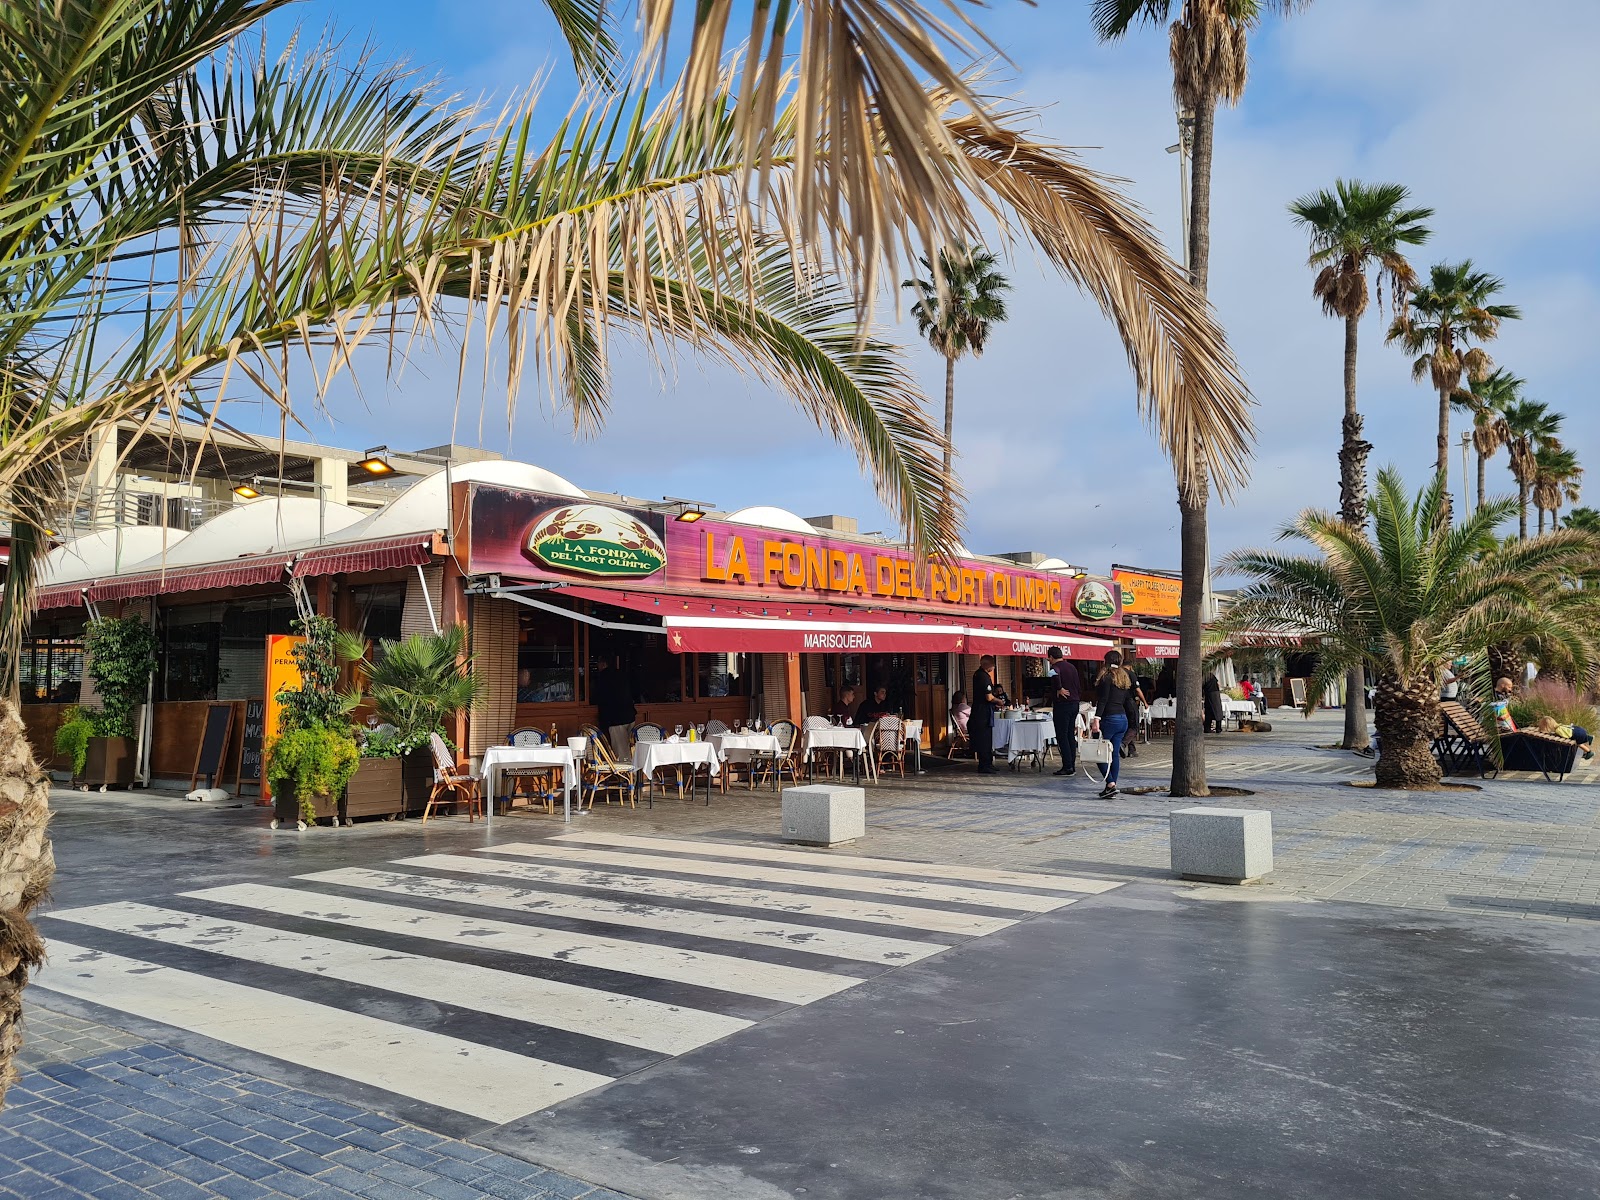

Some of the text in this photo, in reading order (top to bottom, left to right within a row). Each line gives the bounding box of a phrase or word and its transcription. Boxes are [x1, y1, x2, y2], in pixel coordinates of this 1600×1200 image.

[550, 551, 573, 561] DEL
[575, 554, 606, 565] PORT
[565, 543, 639, 560] LA FONDA
[703, 531, 1062, 612] LA FONDA DEL PORT OLIMPIC
[804, 632, 873, 649] MARISQUERÍA
[1012, 641, 1031, 653] CUINA
